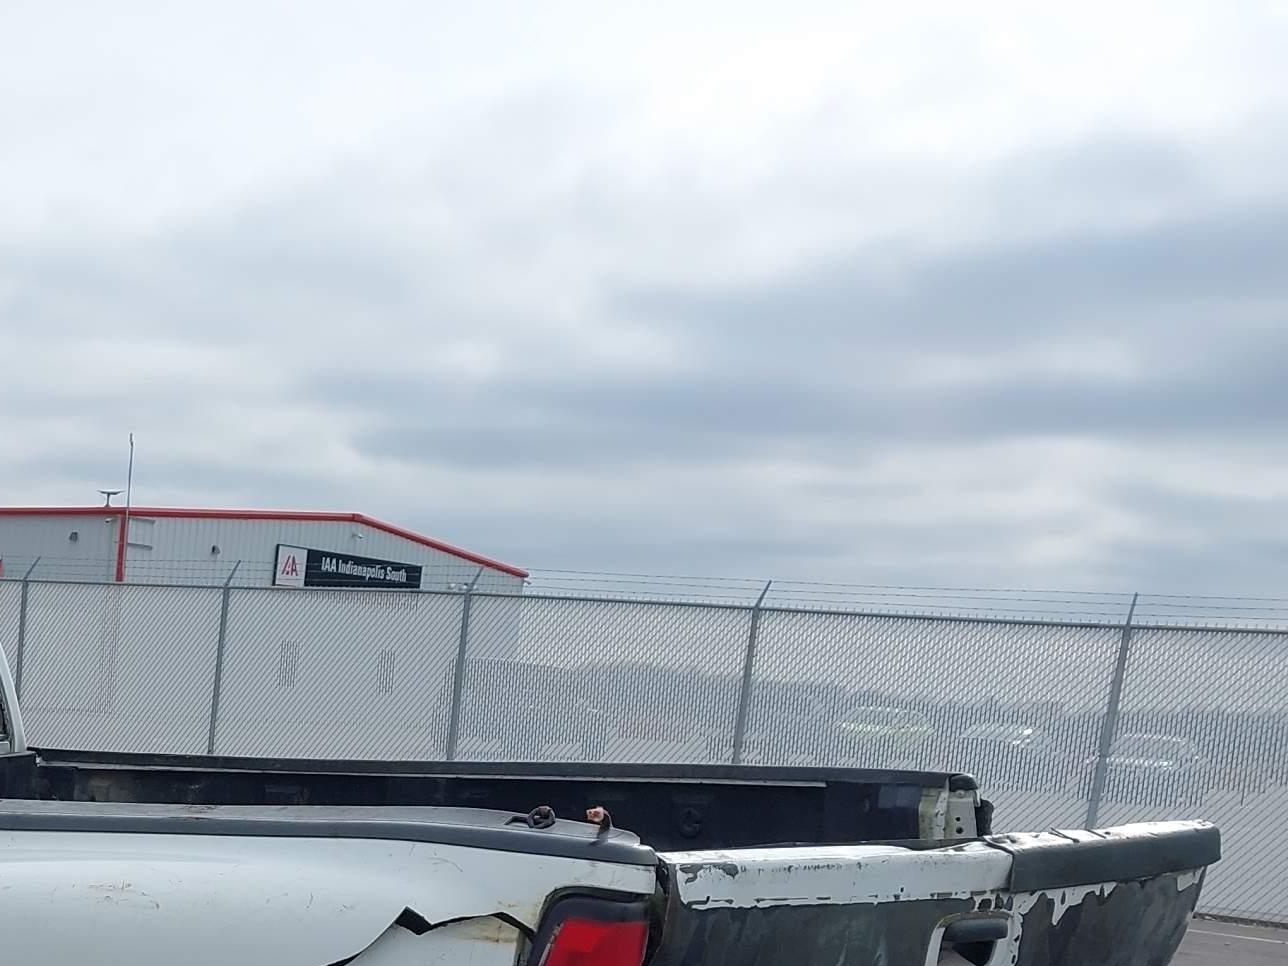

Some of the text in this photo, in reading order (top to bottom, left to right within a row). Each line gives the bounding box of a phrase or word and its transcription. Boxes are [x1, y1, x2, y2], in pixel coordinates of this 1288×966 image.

[321, 556, 407, 583] IAA Indianapolis South
